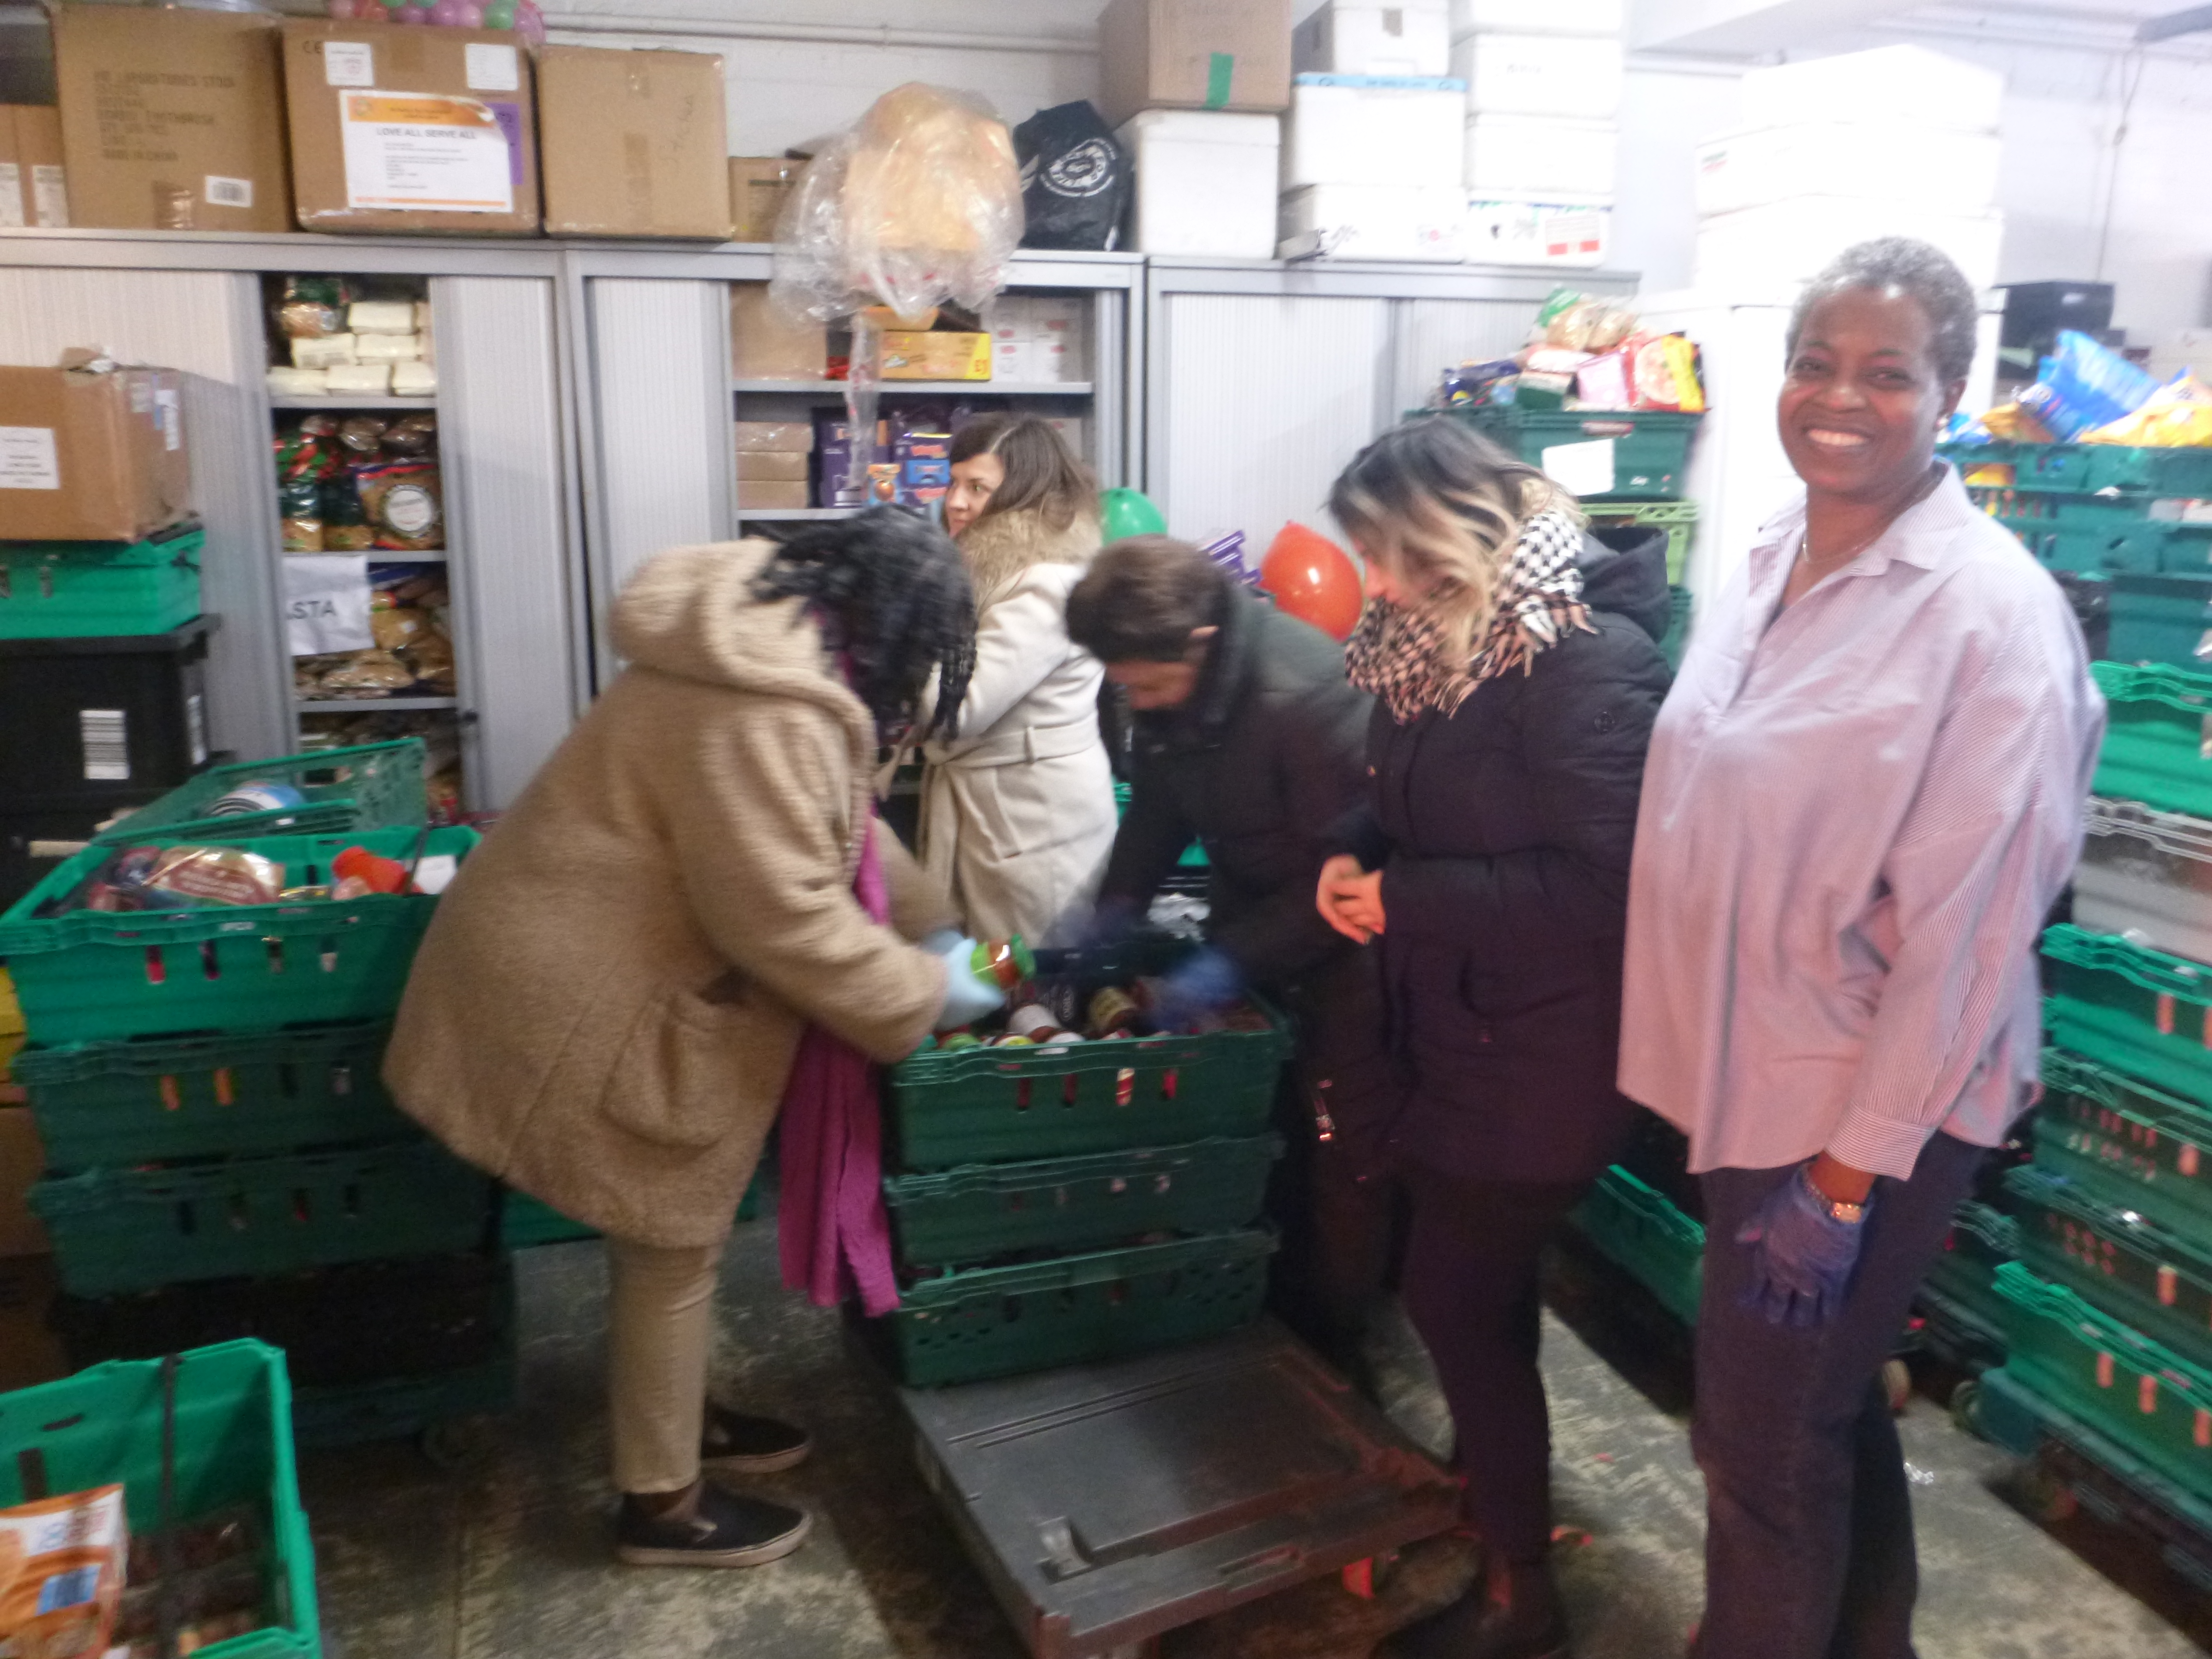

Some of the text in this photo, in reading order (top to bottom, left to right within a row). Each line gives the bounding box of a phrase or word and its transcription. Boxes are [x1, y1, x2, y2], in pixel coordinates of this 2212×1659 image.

[376, 127, 476, 139] LOVE ALL SERVE ALL
[287, 600, 337, 620] STA
